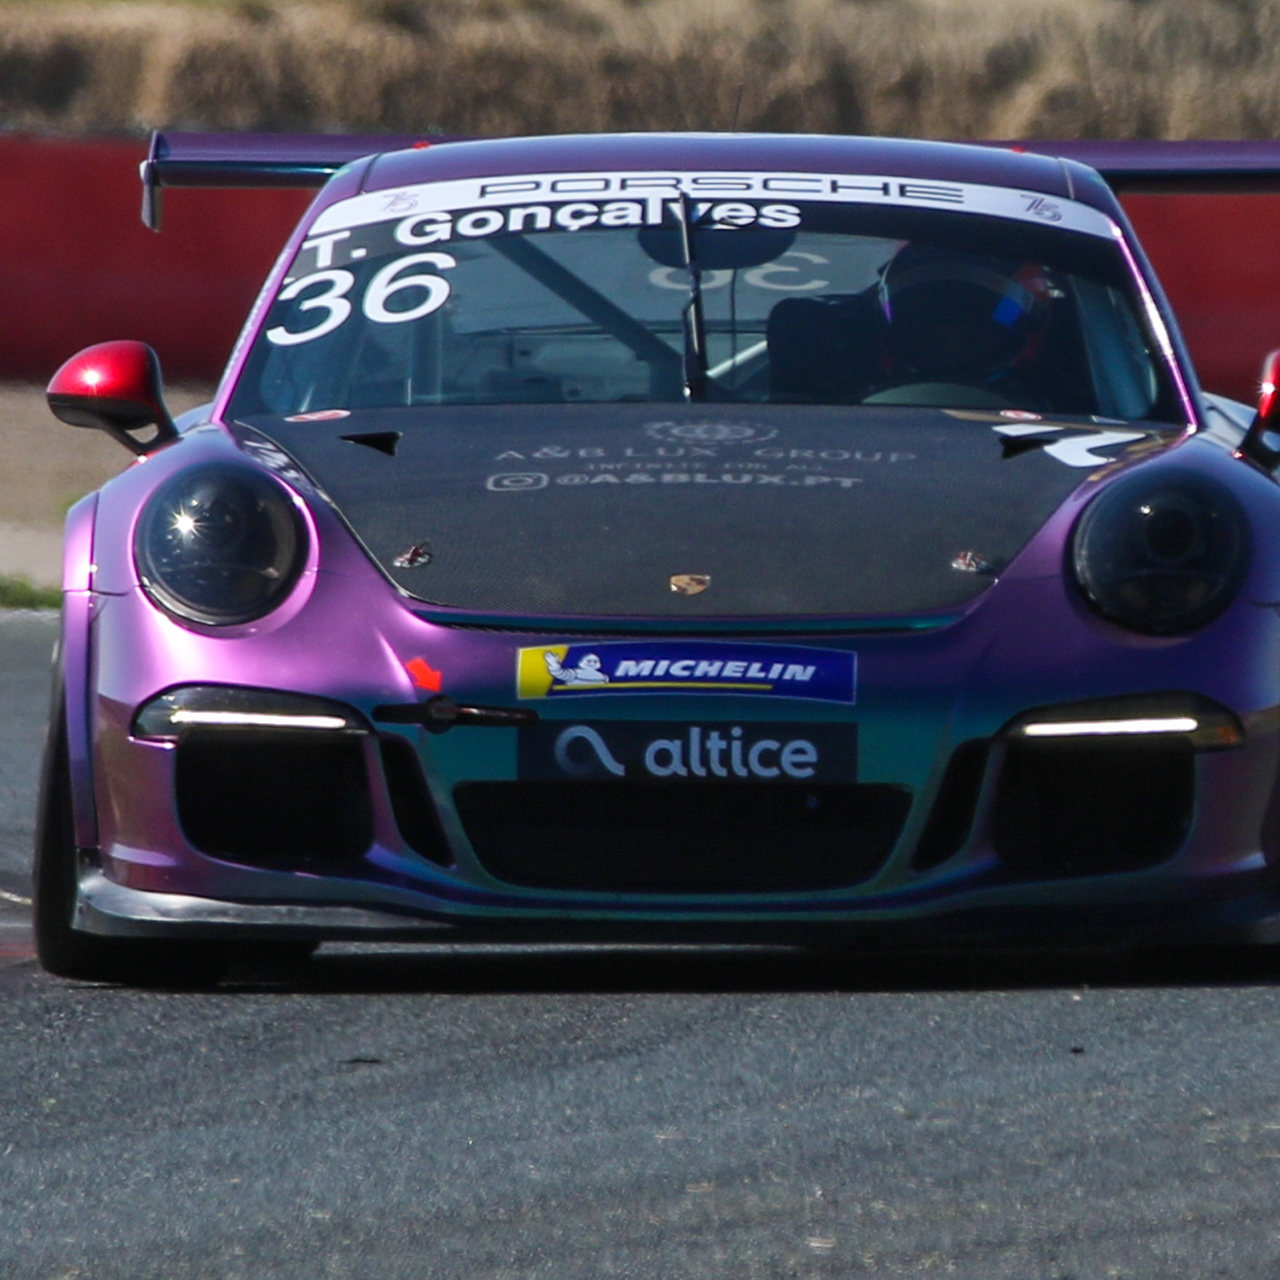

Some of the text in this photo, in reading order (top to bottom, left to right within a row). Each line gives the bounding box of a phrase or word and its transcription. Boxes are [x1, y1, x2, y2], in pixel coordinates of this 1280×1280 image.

[479, 176, 965, 204] PORSCHE
[301, 194, 802, 268] T. Gonçalves
[265, 251, 457, 346] 36
[624, 446, 718, 458] LUX
[753, 447, 918, 464] GROUP
[613, 659, 816, 683] MICHELIN
[644, 726, 819, 778] altice
